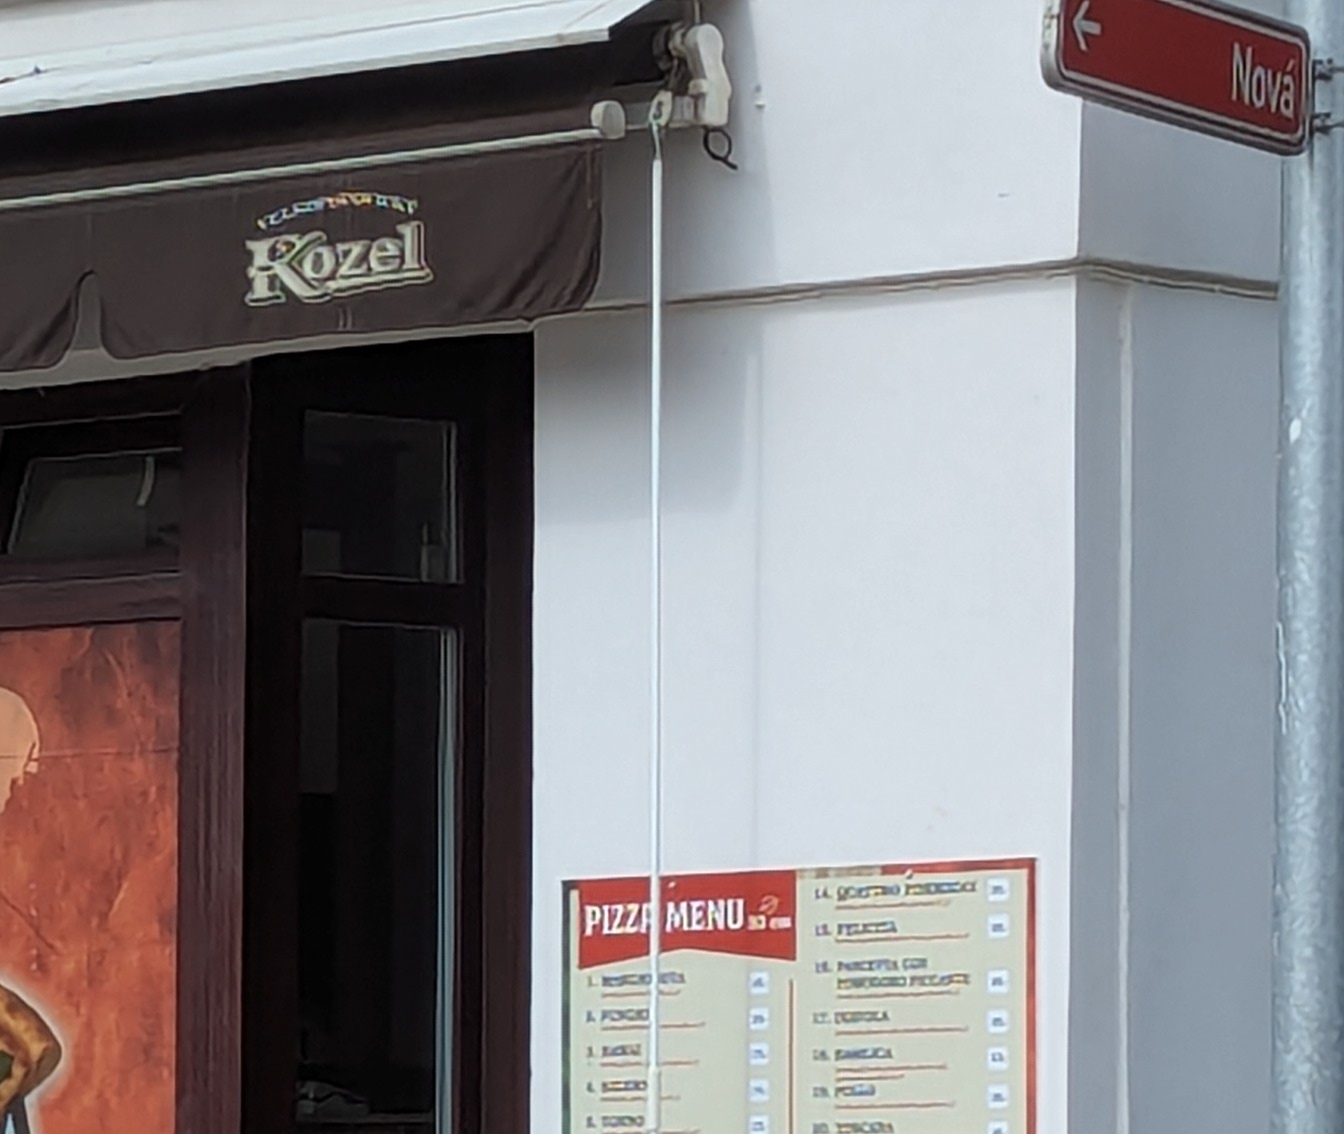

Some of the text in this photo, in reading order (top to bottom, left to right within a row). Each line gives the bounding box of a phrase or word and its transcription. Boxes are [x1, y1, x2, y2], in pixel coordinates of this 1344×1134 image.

[1231, 41, 1295, 119] Nová
[245, 221, 433, 306] Kozel
[665, 898, 745, 933] MENU
